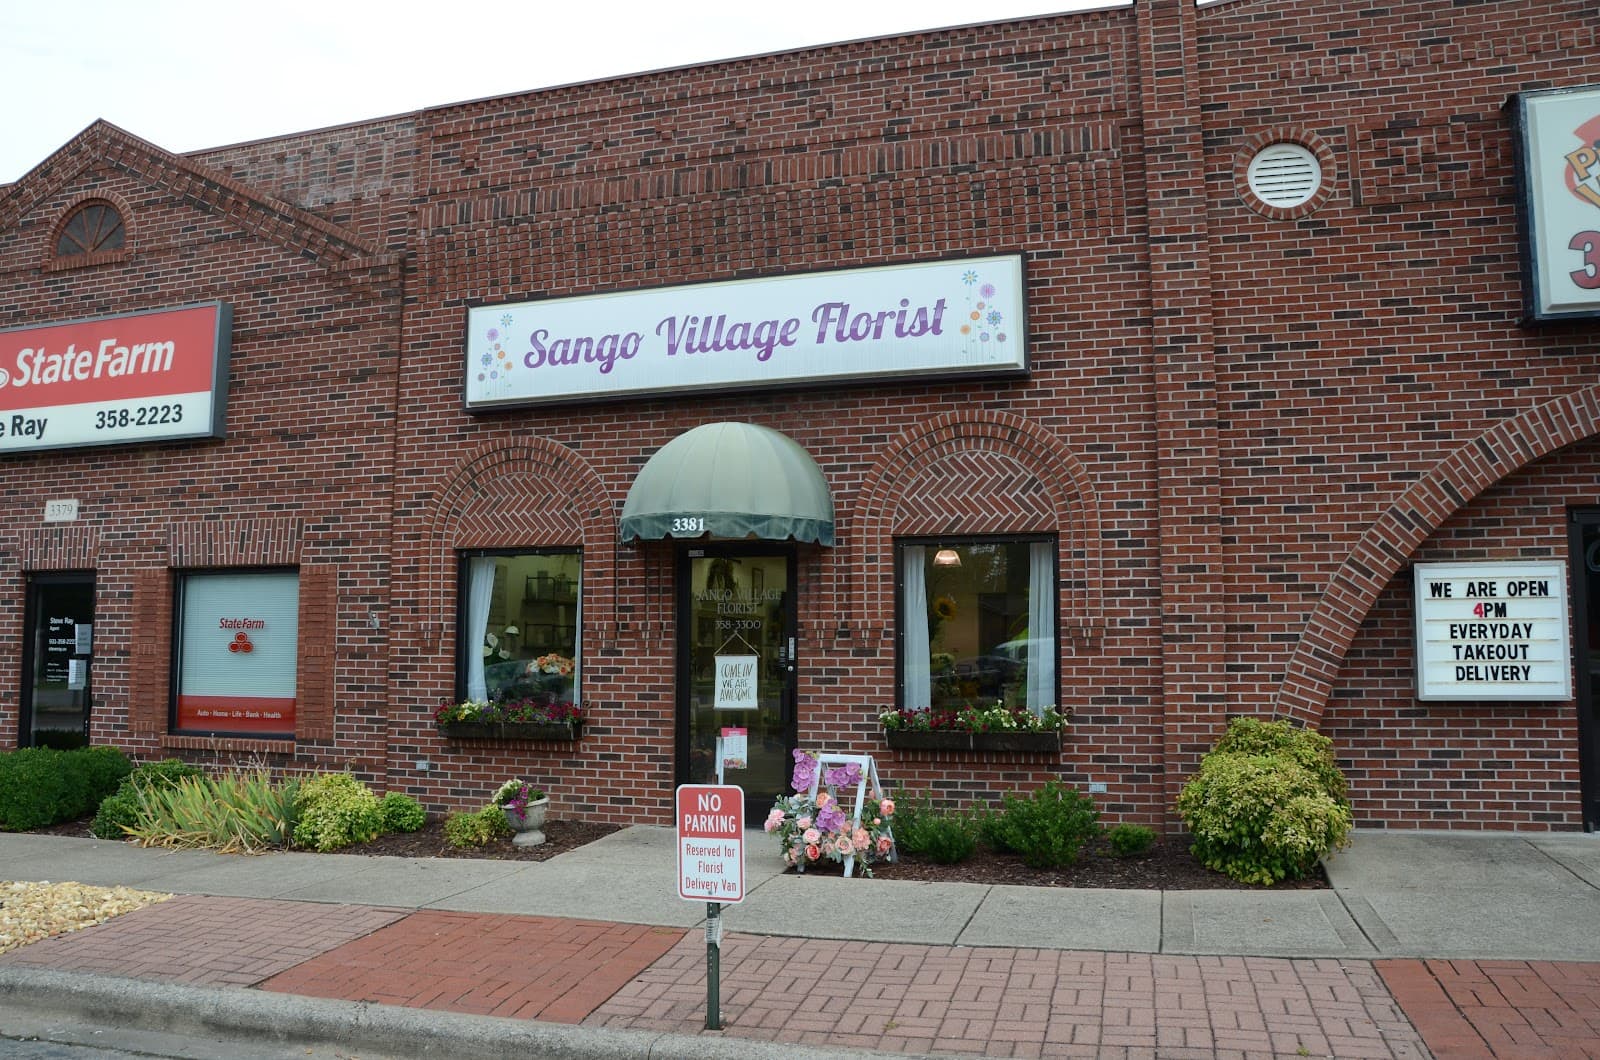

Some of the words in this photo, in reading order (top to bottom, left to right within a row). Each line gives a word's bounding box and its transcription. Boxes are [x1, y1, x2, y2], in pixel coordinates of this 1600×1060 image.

[523, 329, 645, 374] Sango
[656, 314, 800, 362] Village
[811, 298, 948, 344] Florist
[95, 404, 183, 429] 358-2223
[11, 414, 48, 440] Ray
[672, 517, 705, 531] 3381
[696, 589, 733, 601] SANGO
[738, 588, 782, 600] VILLAGE
[1430, 582, 1452, 597] WE
[1466, 581, 1497, 597] ARE
[1507, 580, 1549, 596] OPEN
[717, 602, 759, 614] FLORIST
[1473, 602, 1507, 618] 4PM
[1450, 623, 1533, 639] EVERYDAY
[1453, 644, 1529, 660] TAKEOUT
[721, 664, 741, 678] COME
[743, 663, 753, 677] IN
[1455, 665, 1531, 681] DELIVERY
[722, 679, 733, 688] WE
[735, 679, 749, 688] ARE
[720, 687, 752, 701] AWESOME
[197, 709, 210, 717] Auto
[231, 710, 242, 718] Life
[263, 711, 282, 719] Health
[698, 794, 722, 812] NO
[684, 814, 736, 833] PARKING
[686, 843, 721, 857] Reserved
[724, 845, 736, 858] for
[698, 860, 724, 874] Florist
[685, 877, 718, 894] Delivery
[721, 879, 737, 892] Van
